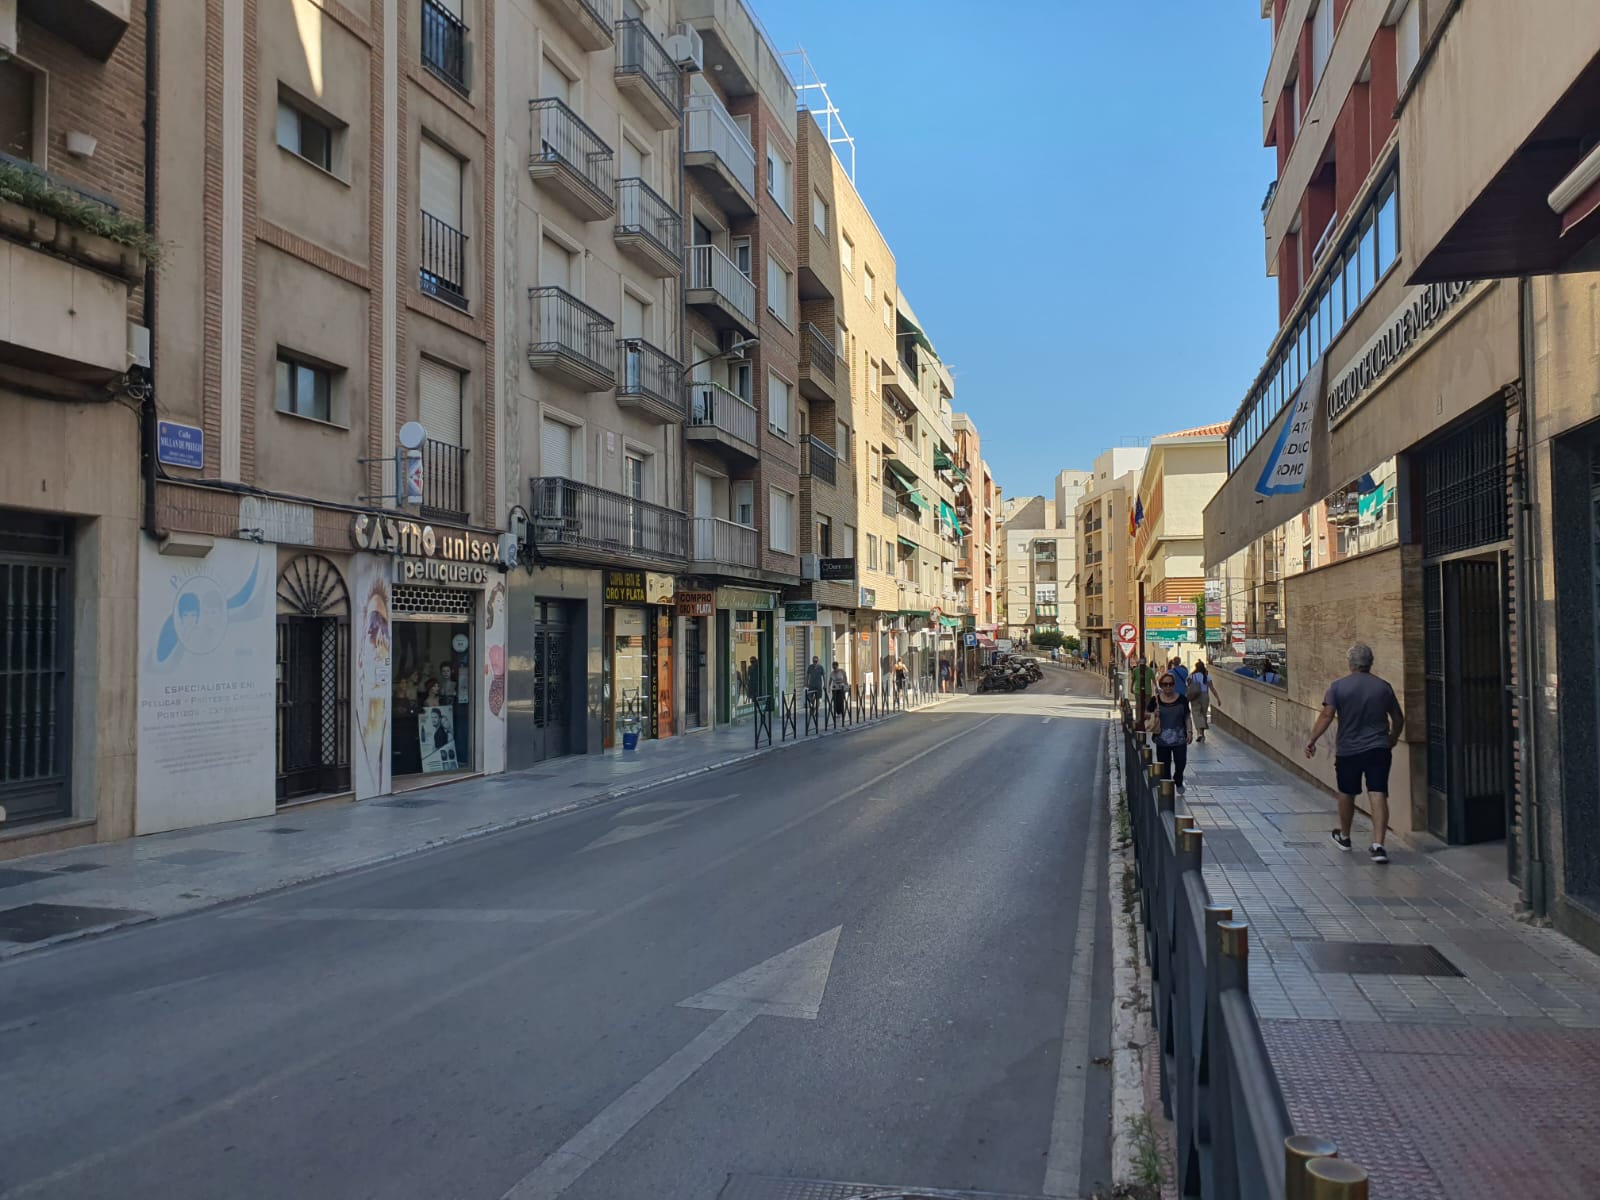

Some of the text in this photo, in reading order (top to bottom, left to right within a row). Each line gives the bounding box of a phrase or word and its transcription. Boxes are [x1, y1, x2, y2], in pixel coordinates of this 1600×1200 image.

[1327, 367, 1358, 421] COLEGIO
[1359, 328, 1395, 390] OFICIAL
[1395, 310, 1411, 355] DE
[355, 513, 500, 563] CASTRO unisex
[404, 557, 488, 584] peluqueros
[605, 586, 645, 601] ORO Y PLATA
[680, 593, 712, 602] COMPRO
[696, 603, 712, 614] PLATA
[966, 635, 974, 645] P
[164, 680, 238, 694] ESPECIALISTAS
